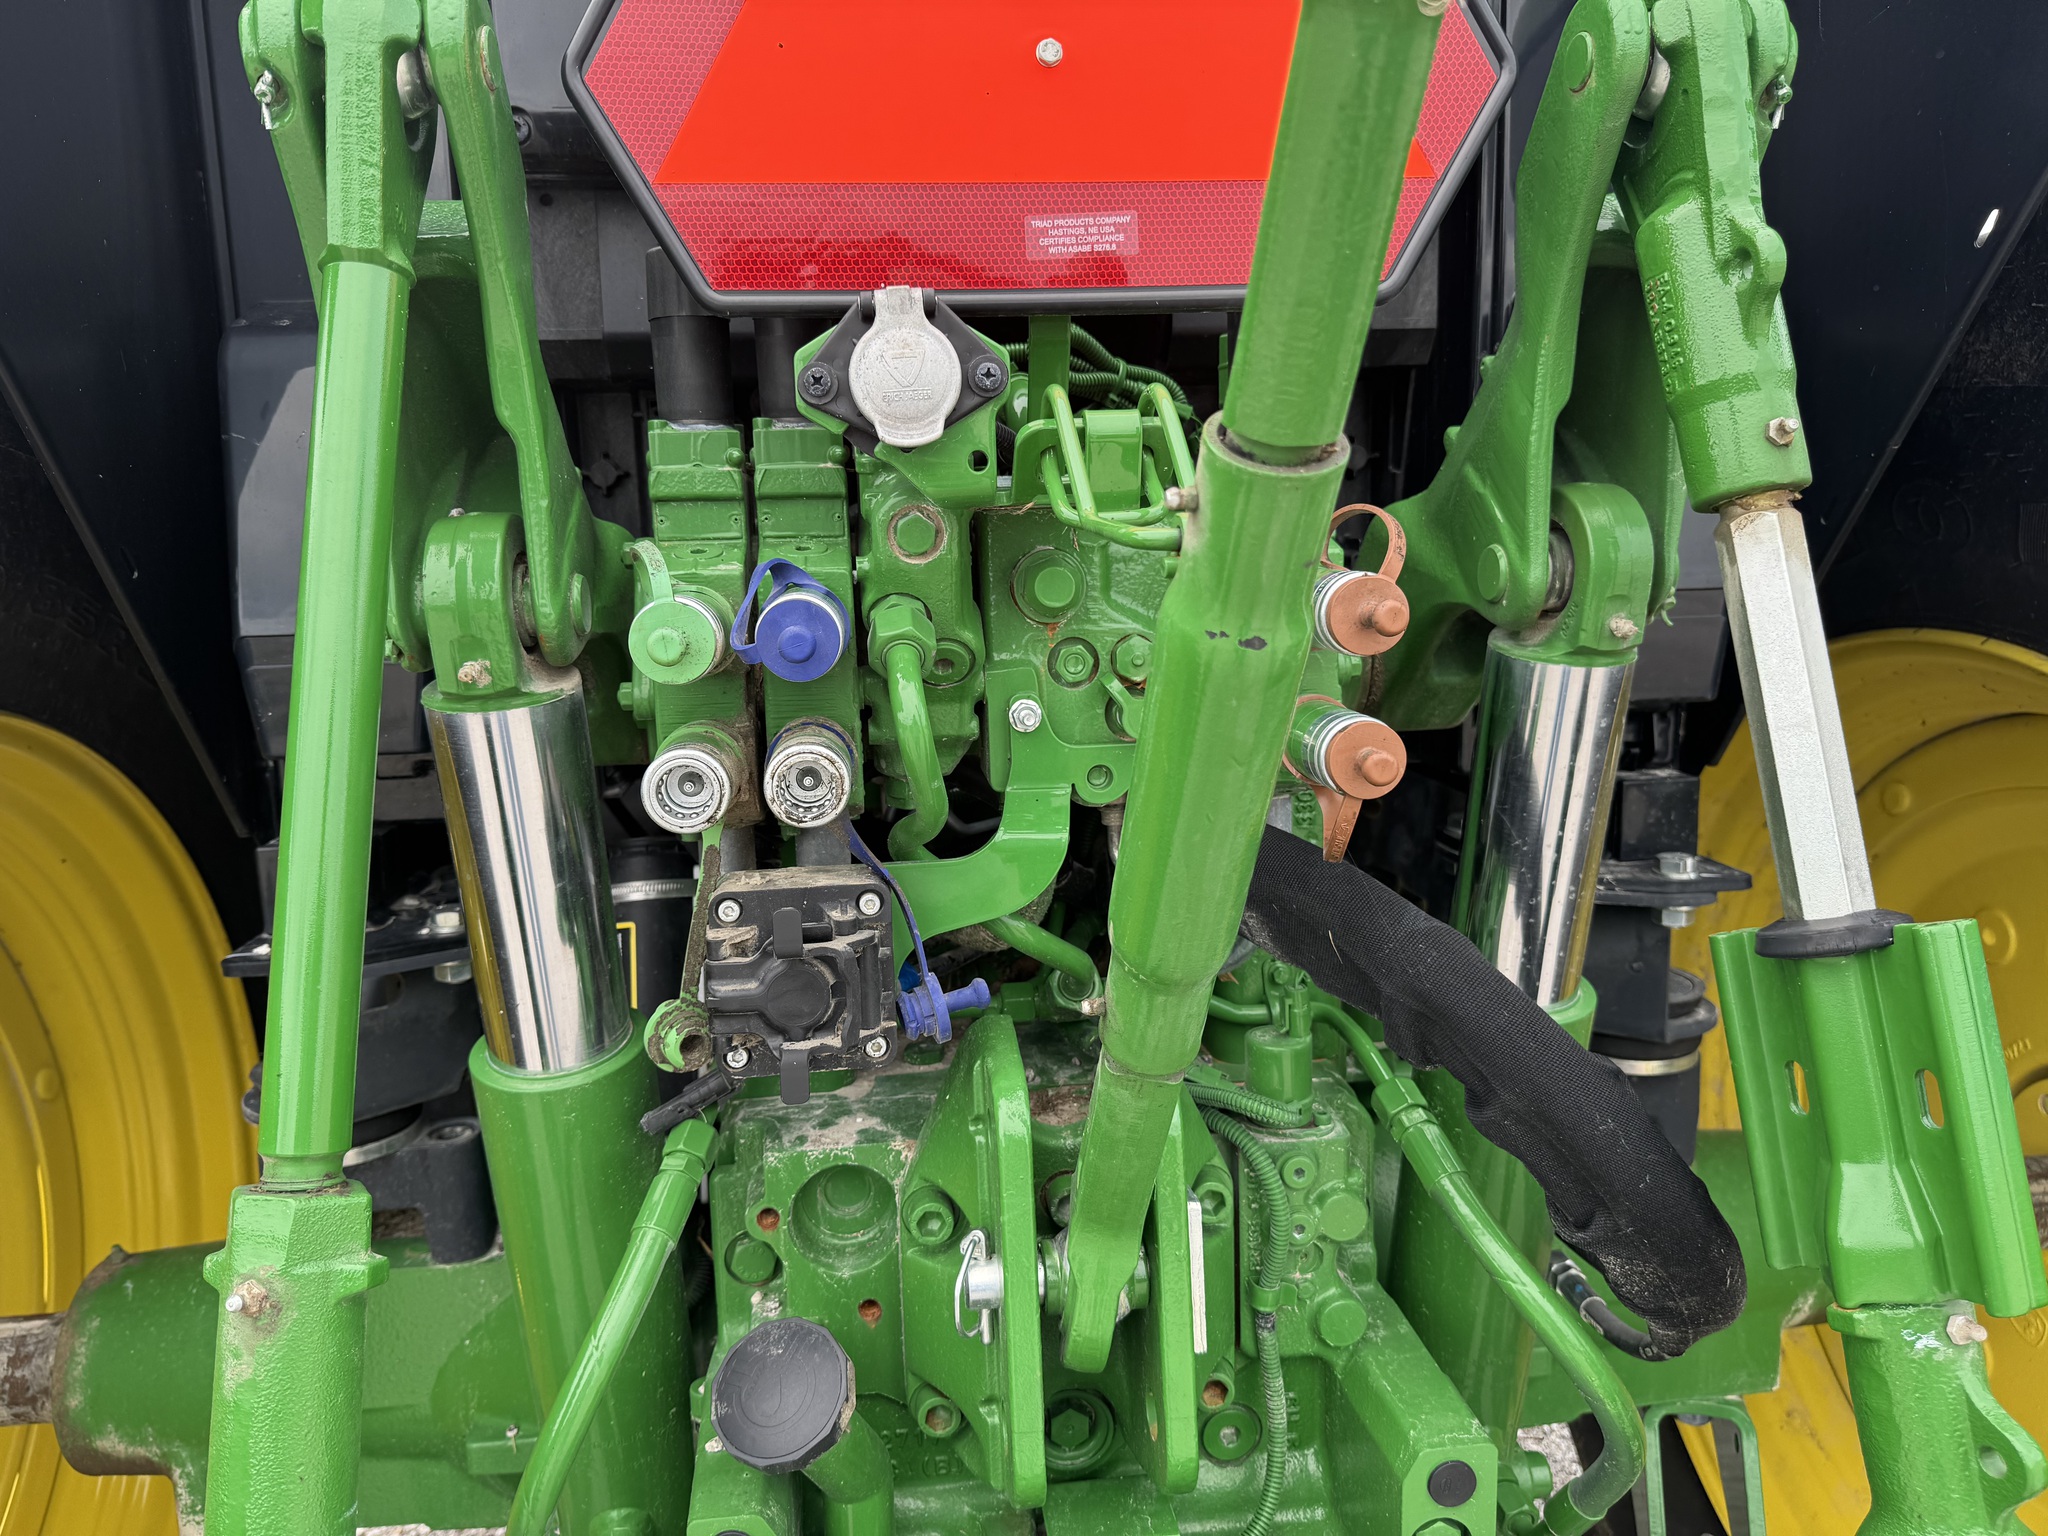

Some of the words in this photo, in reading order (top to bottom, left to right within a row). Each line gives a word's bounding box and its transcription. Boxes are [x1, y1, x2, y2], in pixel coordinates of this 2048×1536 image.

[1031, 220, 1053, 228] TRIAD
[1054, 217, 1094, 227] PRODUCTS
[1095, 215, 1131, 225] COMPANY
[1048, 227, 1087, 236] HASTINGS,
[1099, 225, 1115, 233] USA
[1039, 236, 1077, 246] CERTIFIES
[1077, 233, 1125, 243] COMPLIANCE
[1048, 246, 1068, 254] WITH
[1068, 244, 1092, 253] ASABE
